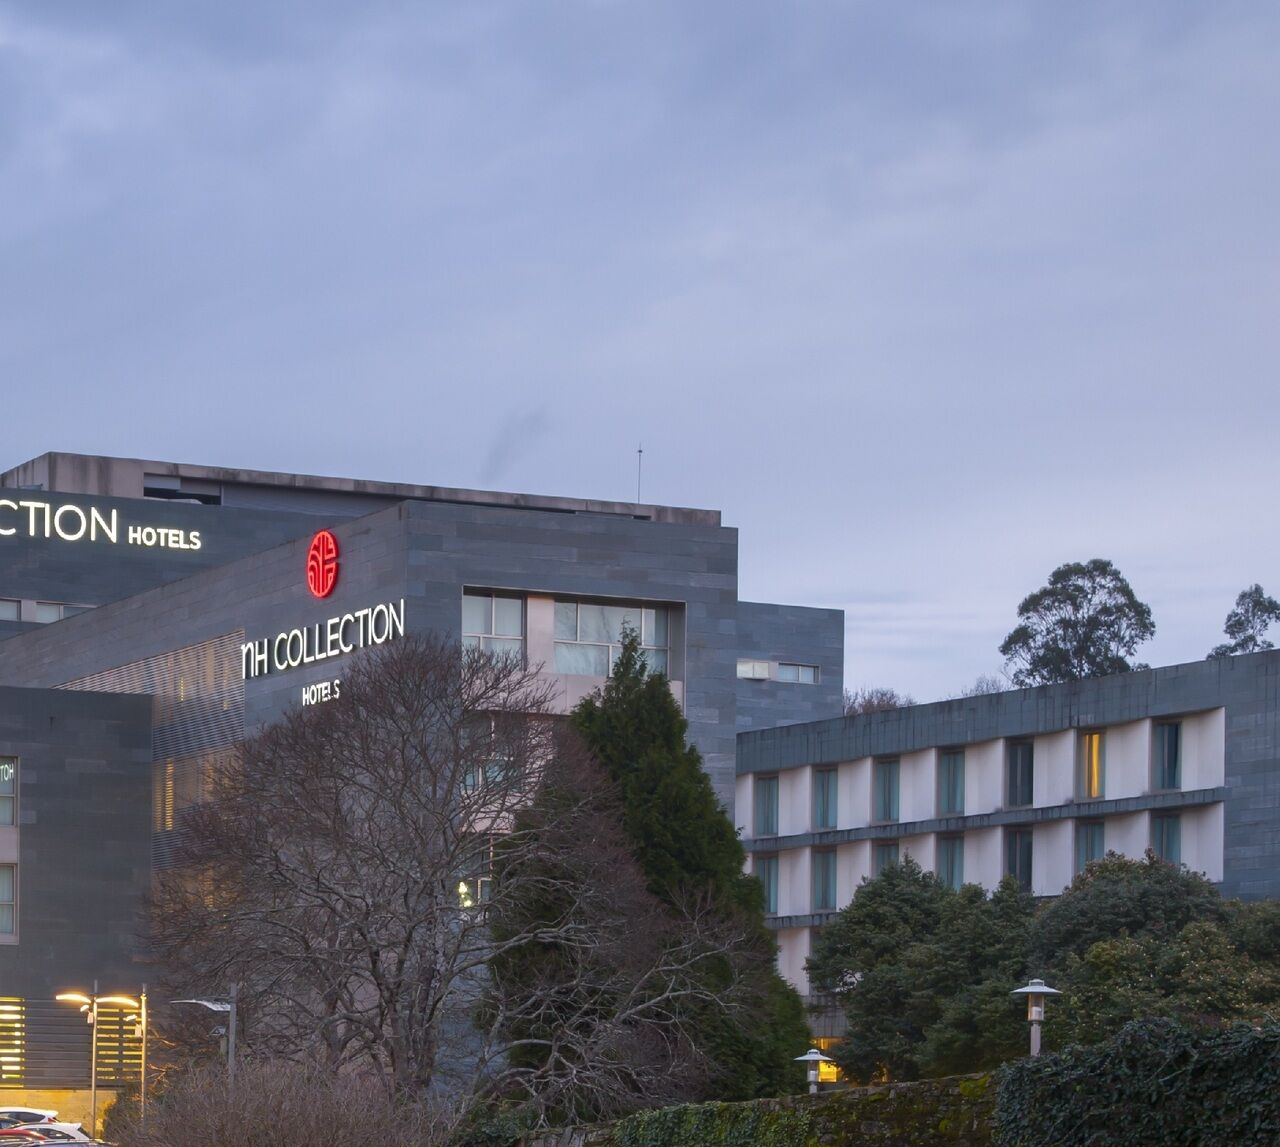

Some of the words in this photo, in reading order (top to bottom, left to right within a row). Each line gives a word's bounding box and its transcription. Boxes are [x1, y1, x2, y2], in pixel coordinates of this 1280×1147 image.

[128, 525, 202, 550] HOTELS
[274, 598, 406, 670] COLLECTION
[302, 679, 341, 707] HOTELS
